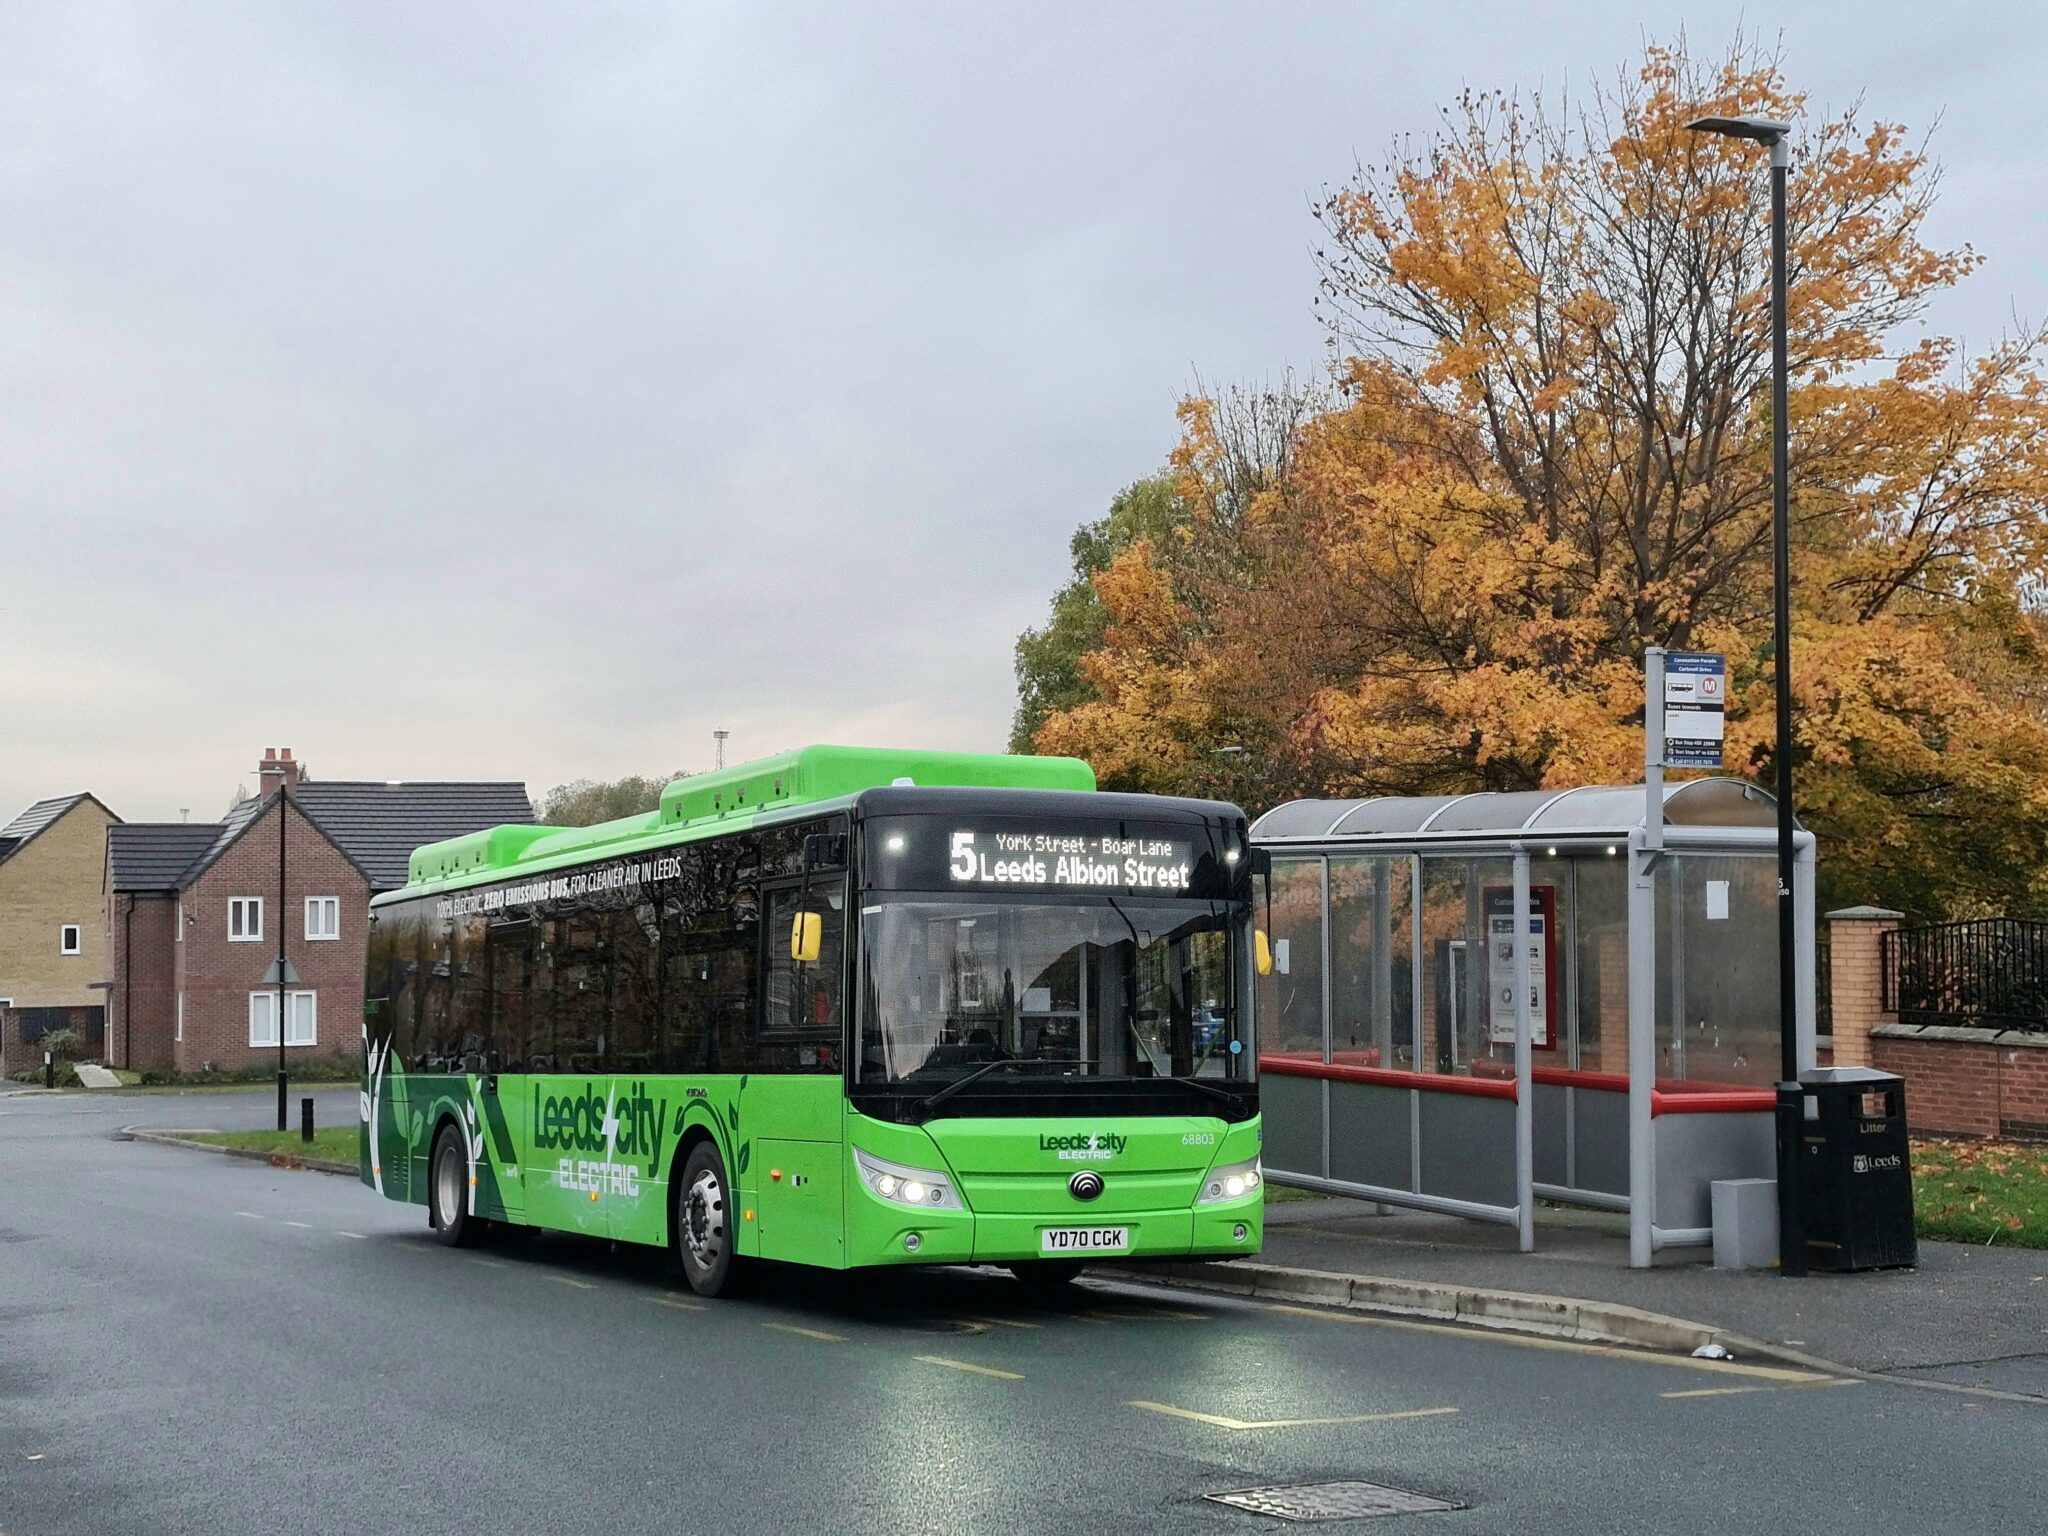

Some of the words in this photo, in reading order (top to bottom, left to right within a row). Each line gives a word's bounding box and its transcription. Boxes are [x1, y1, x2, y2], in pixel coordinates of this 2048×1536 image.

[1704, 680, 1716, 691] M
[996, 833, 1031, 851] York
[1035, 836, 1086, 853] Street
[1102, 838, 1136, 855] Boar
[1139, 841, 1172, 856] Lane
[950, 832, 977, 880] 5
[980, 853, 1047, 883] Leeds
[1054, 856, 1118, 886] Albion
[1124, 859, 1190, 888] Street
[436, 899, 453, 918] 100%
[484, 890, 504, 910] ZERO
[505, 881, 550, 906] EMISSIONS
[570, 874, 587, 894] FOR
[588, 867, 624, 892] CLEANER
[625, 864, 640, 886] AIR
[641, 861, 652, 883] IN
[653, 856, 682, 881] LEEDS
[1860, 1122, 1888, 1134] Litter
[1182, 1134, 1214, 1146] 68803
[1058, 1150, 1112, 1160] ELECTRIC
[1868, 1154, 1901, 1168] Leeds
[558, 1158, 640, 1198] ELECTRIC
[1048, 1230, 1088, 1248] YD70
[1092, 1230, 1122, 1246] CGK
